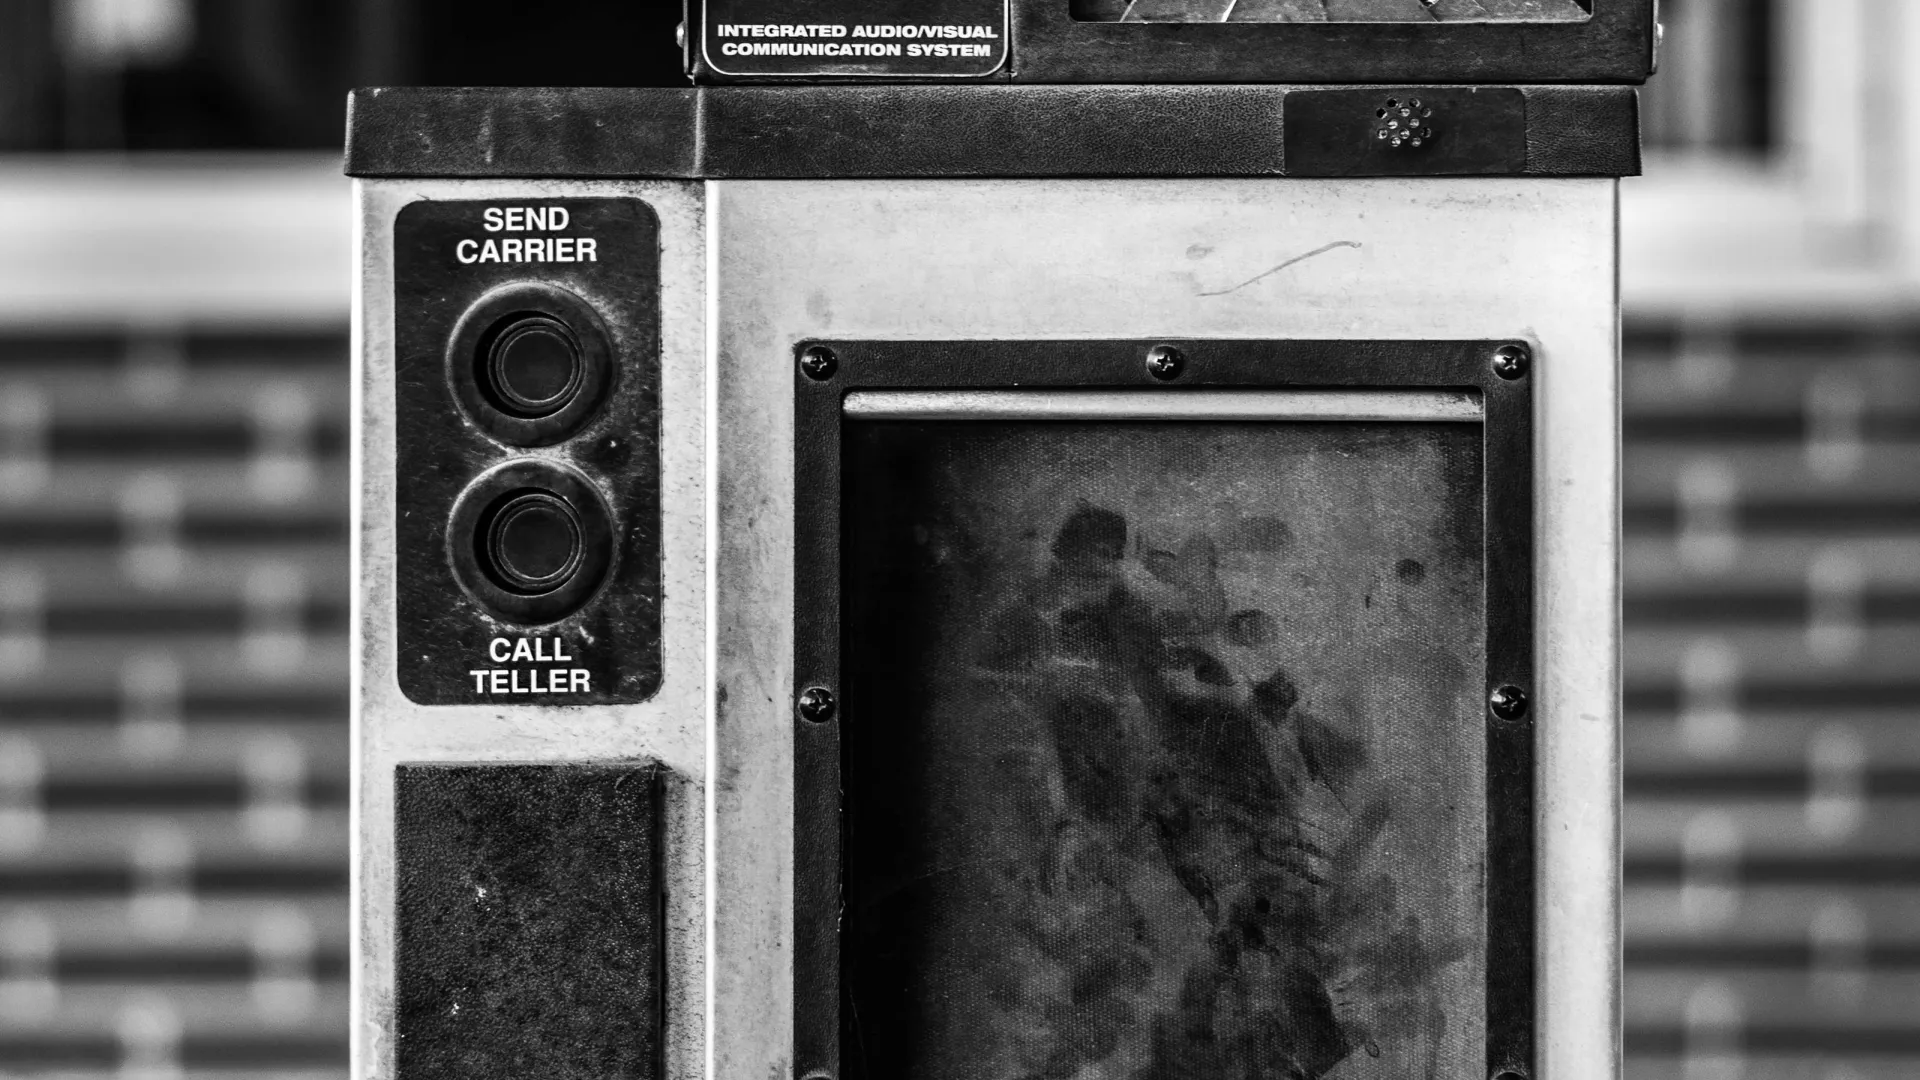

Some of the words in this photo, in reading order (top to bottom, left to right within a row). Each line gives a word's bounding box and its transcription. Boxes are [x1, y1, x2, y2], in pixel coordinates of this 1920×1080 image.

[718, 25, 847, 38] INTEGRATED
[852, 25, 998, 39] AUDIO/VISUAL
[722, 43, 901, 56] COMMUNICATION
[907, 44, 990, 57] SYSTEM
[483, 207, 570, 231] SEND
[456, 238, 598, 264] CARRIER
[489, 638, 573, 662] CALL
[469, 669, 591, 693] TELLER
